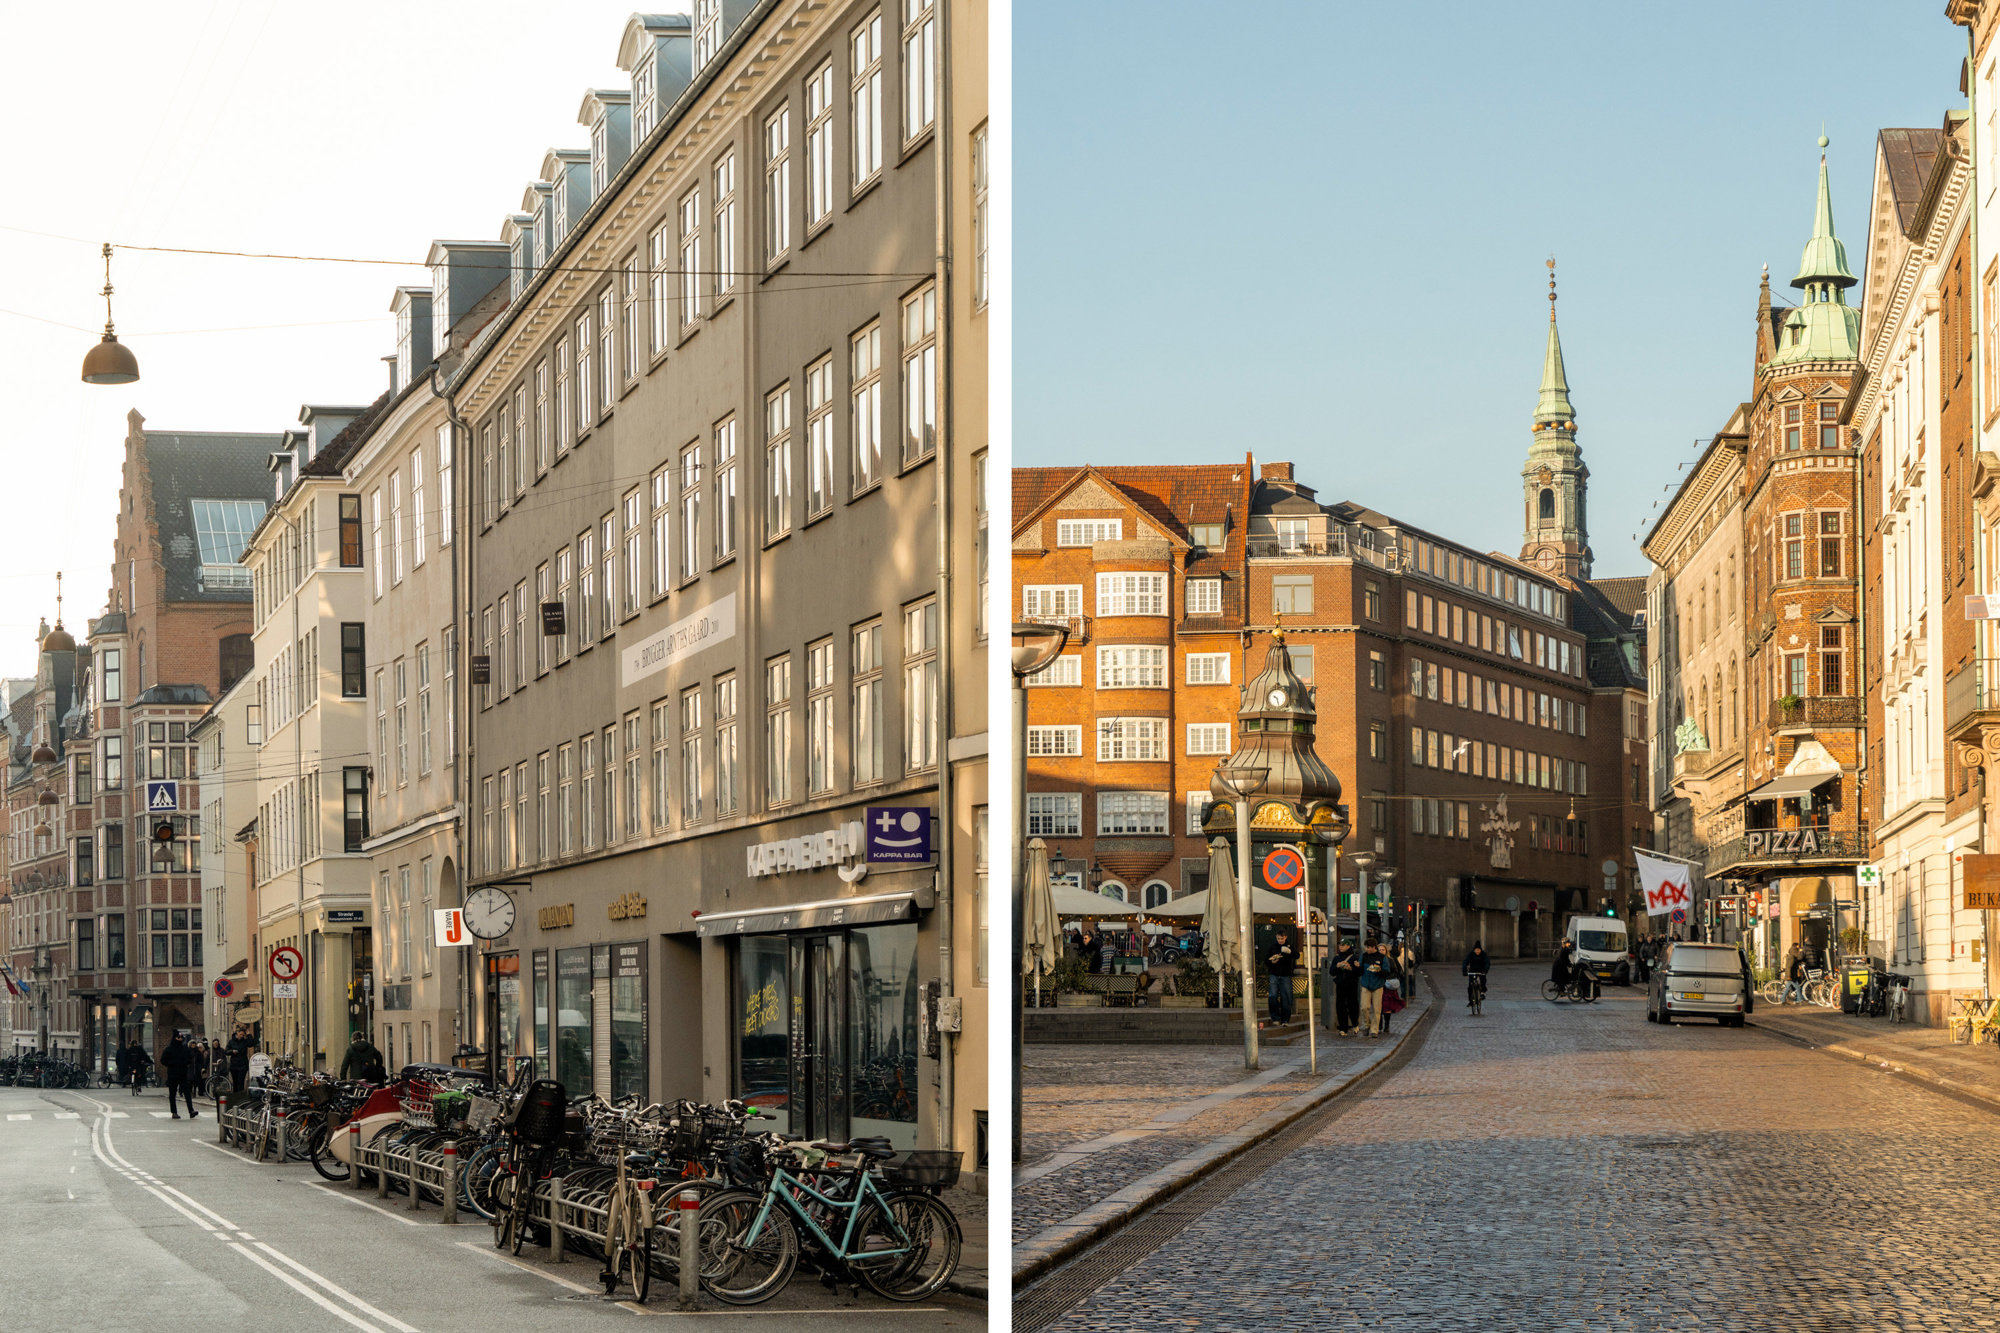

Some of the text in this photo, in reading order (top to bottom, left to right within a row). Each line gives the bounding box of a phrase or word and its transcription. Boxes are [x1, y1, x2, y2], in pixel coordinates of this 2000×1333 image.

[642, 640, 666, 667] BRYGGER
[689, 618, 708, 644] GAARD
[746, 829, 841, 877] KAPPA BAR
[1749, 829, 1818, 854] PIZZA
[1647, 880, 1690, 909] MAX
[445, 910, 453, 929] WARE
